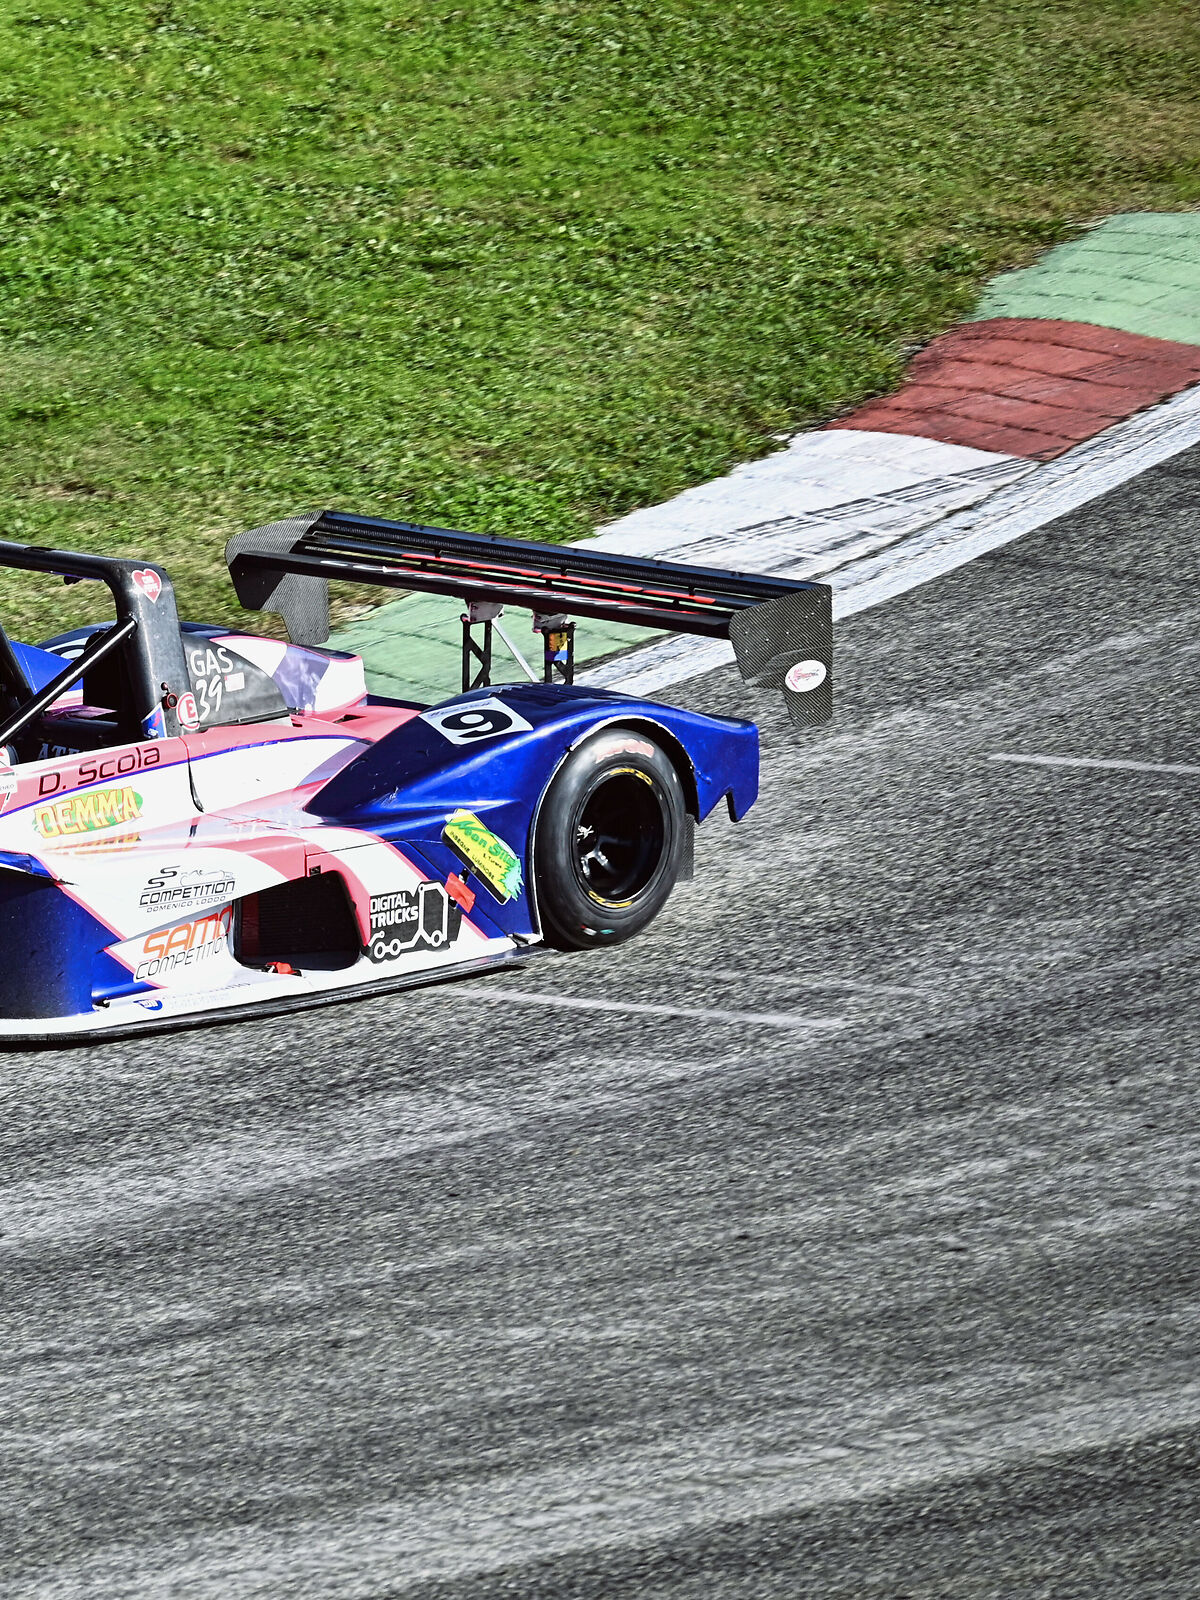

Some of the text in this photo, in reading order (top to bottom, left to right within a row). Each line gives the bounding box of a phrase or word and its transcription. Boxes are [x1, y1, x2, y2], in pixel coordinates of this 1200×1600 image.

[190, 647, 234, 677] GAS
[185, 699, 196, 719] E
[196, 674, 223, 721] 39
[440, 708, 513, 739] 9
[38, 746, 161, 796] D. Scola
[139, 880, 236, 906] COMPETITION
[146, 895, 226, 913] DOMENICO LODDO
[370, 892, 410, 913] DIGITAL
[370, 905, 419, 929] TRUCKS
